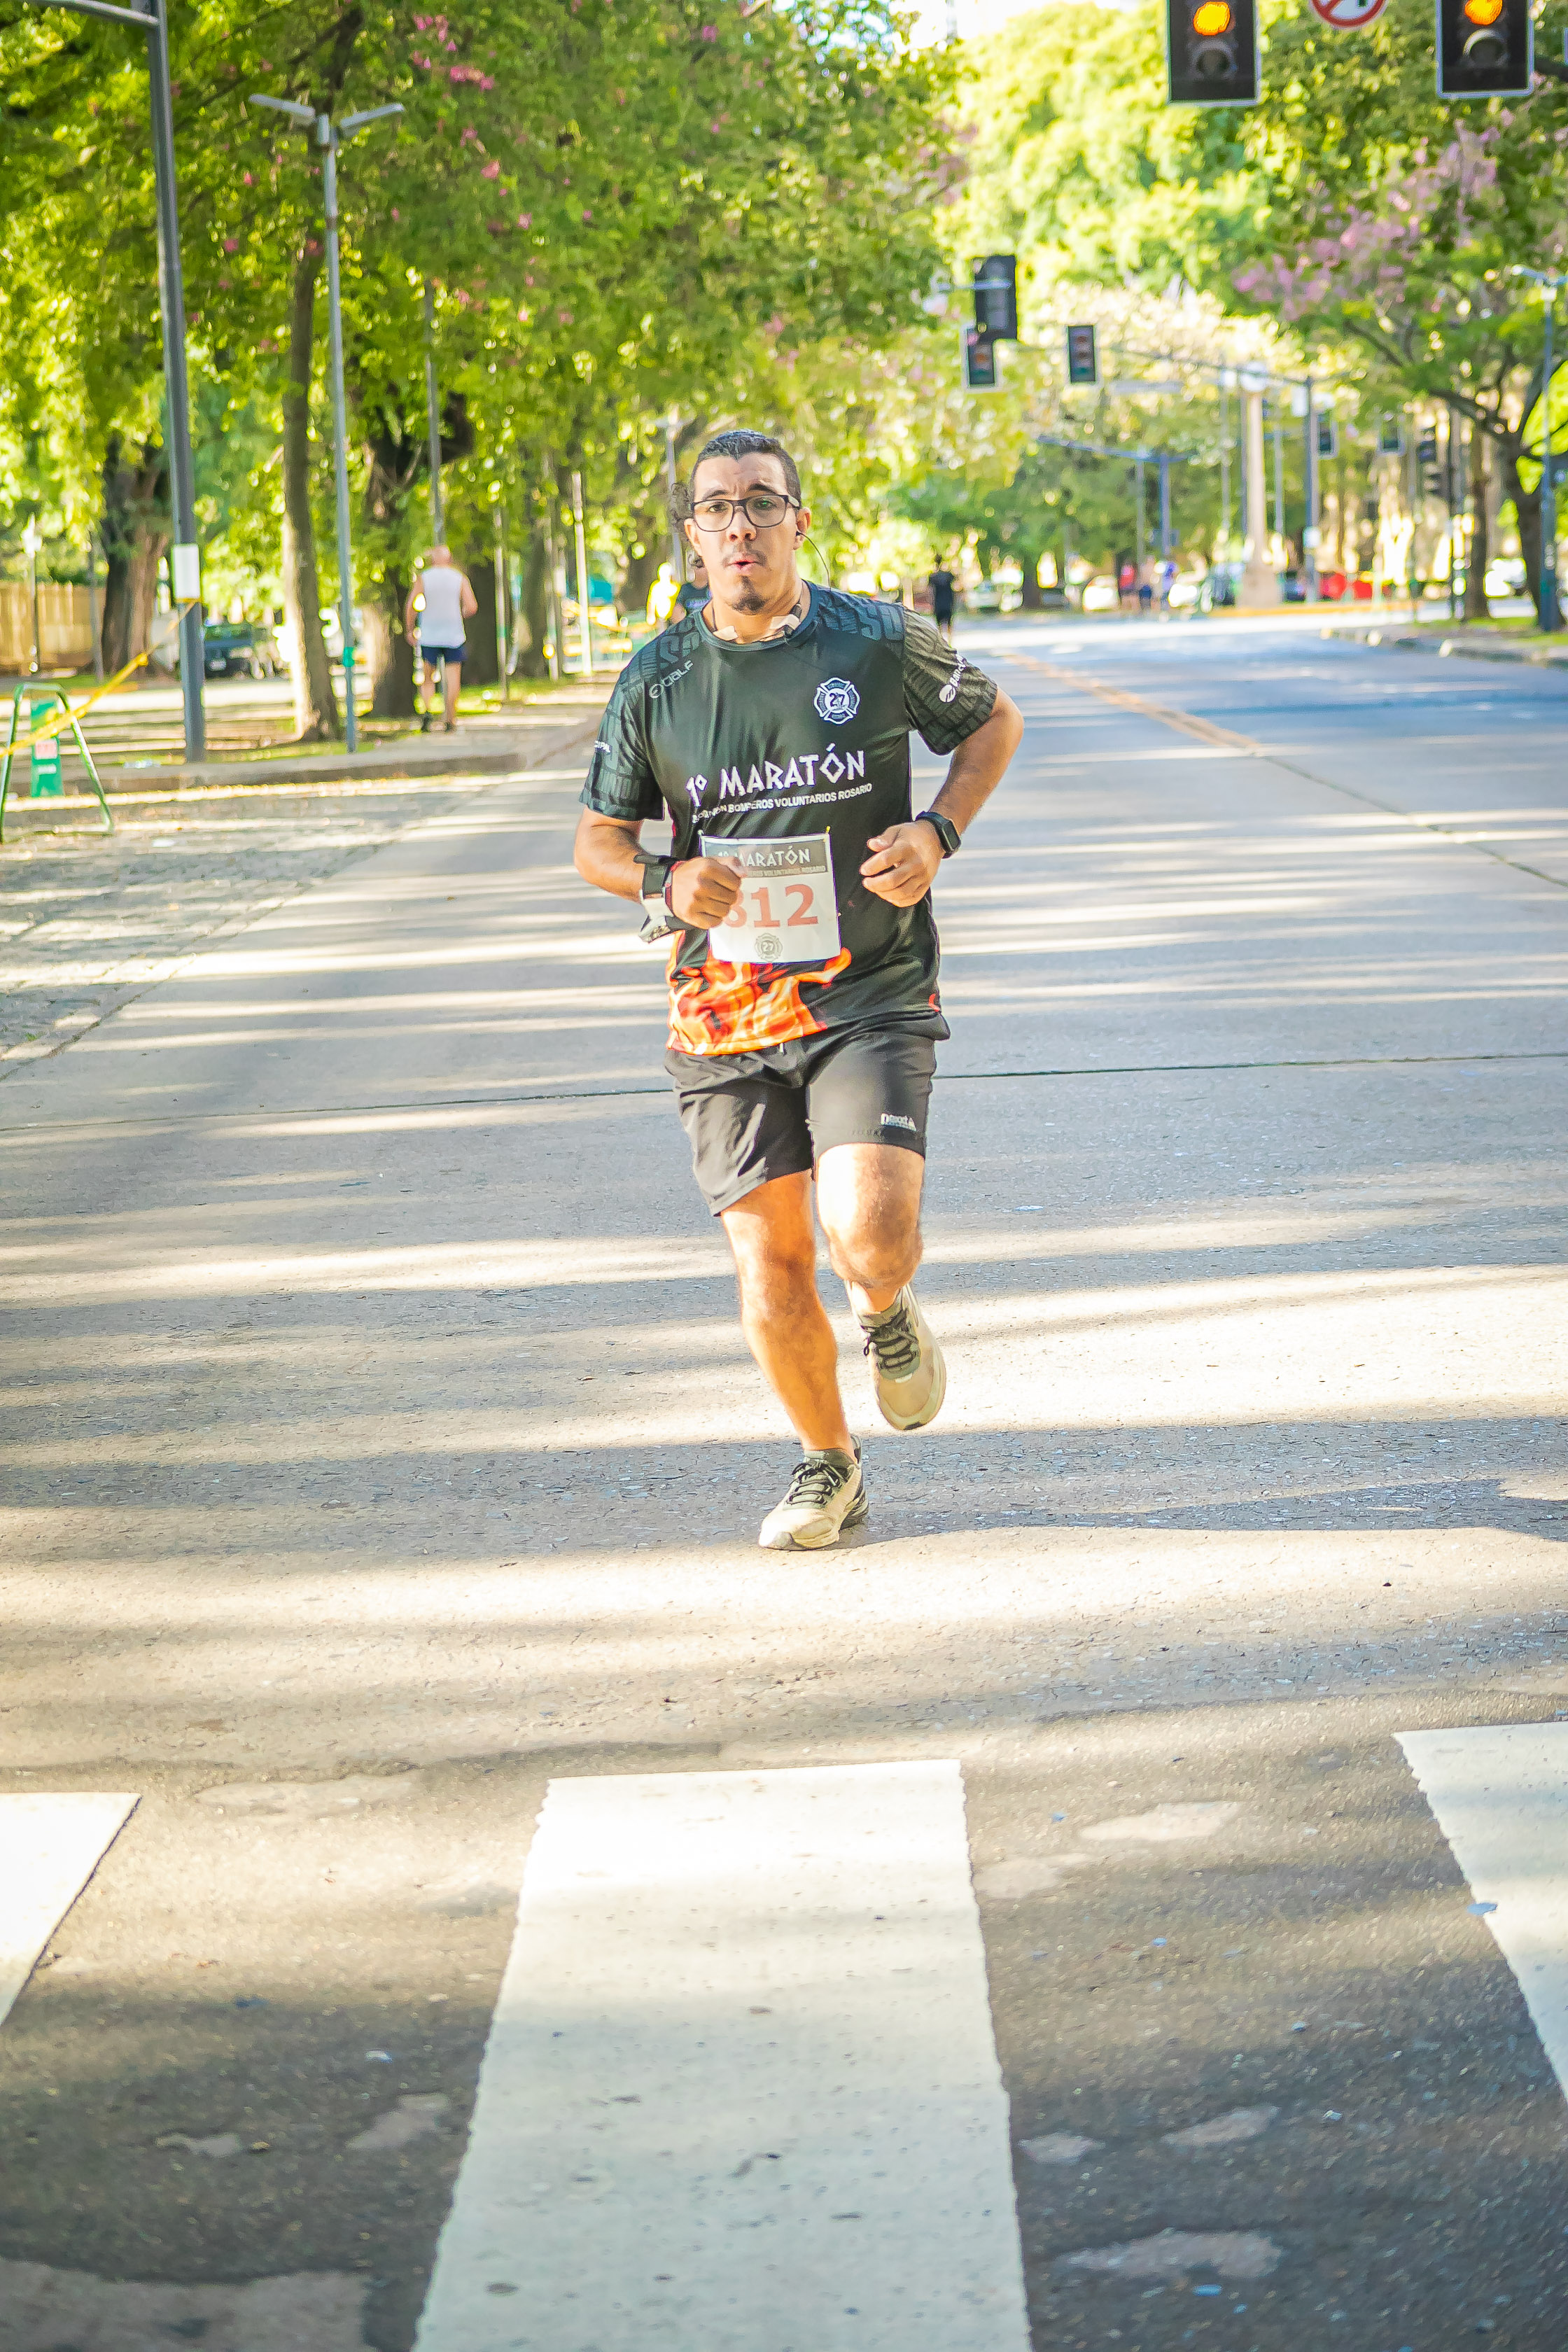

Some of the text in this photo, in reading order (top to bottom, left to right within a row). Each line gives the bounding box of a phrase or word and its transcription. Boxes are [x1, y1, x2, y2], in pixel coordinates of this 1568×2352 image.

[830, 692, 845, 707] 27
[719, 743, 864, 800] MARATÓN
[774, 792, 837, 808] VOLUNTARIOS
[838, 783, 872, 800] ROSARIO
